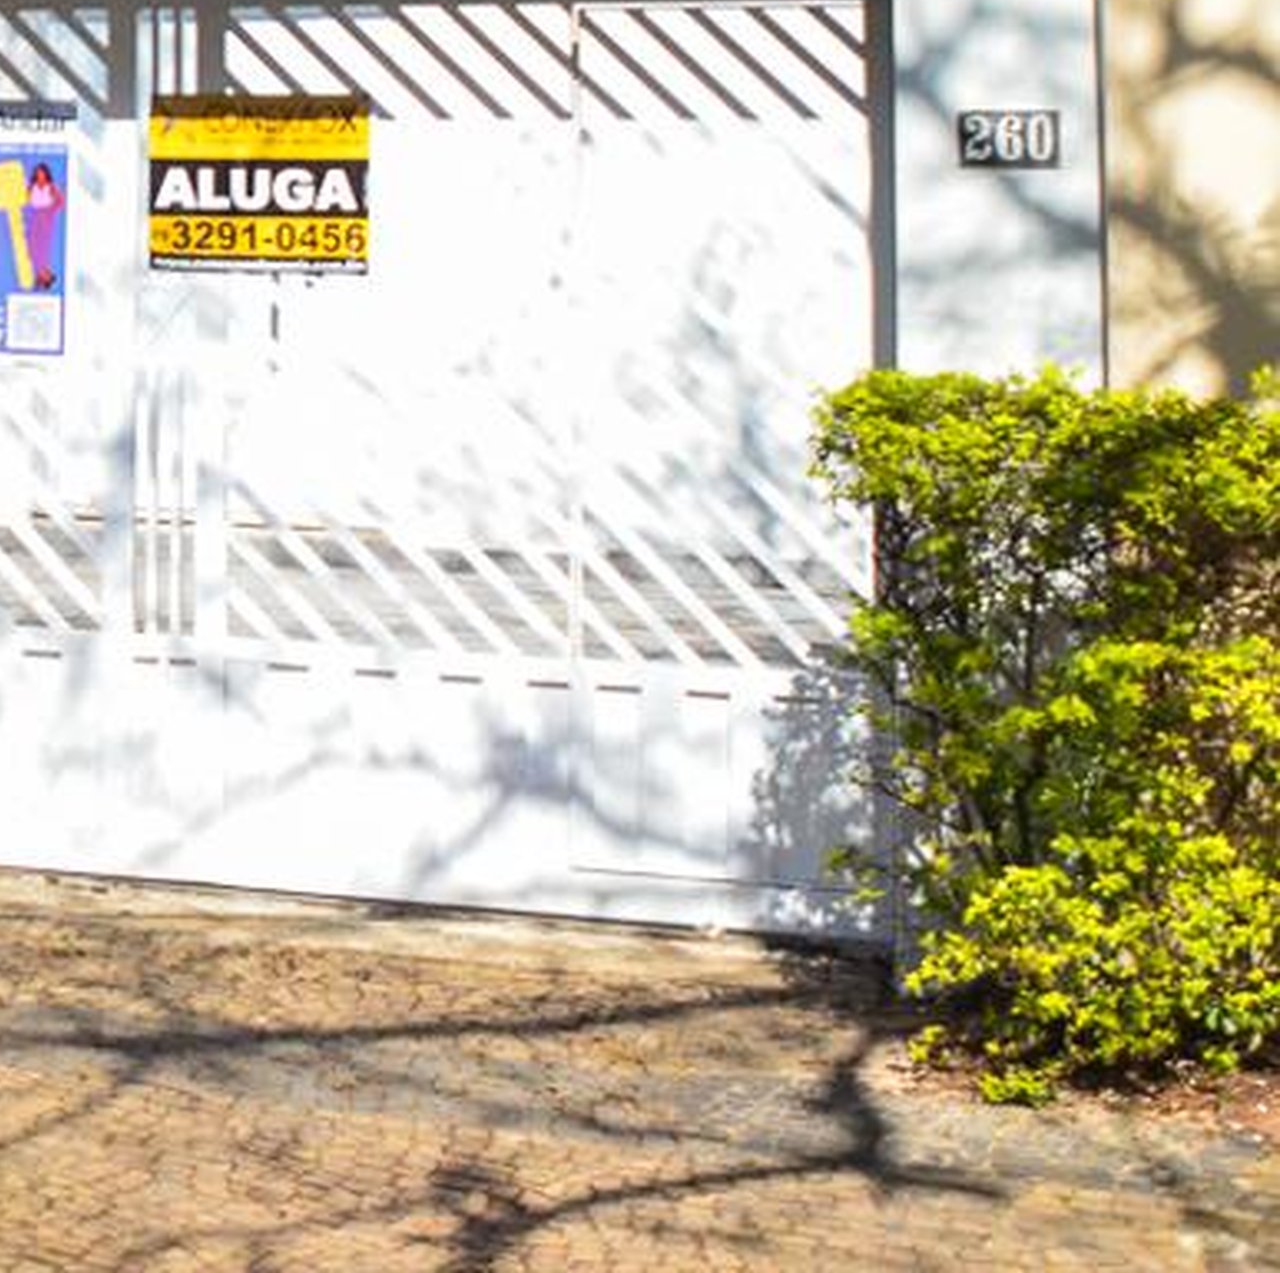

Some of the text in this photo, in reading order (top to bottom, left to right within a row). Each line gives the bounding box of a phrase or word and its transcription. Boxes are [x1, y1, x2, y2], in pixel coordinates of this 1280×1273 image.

[964, 113, 1053, 161] 260
[153, 166, 359, 212] ALUGA
[171, 220, 366, 254] 3291-0456
